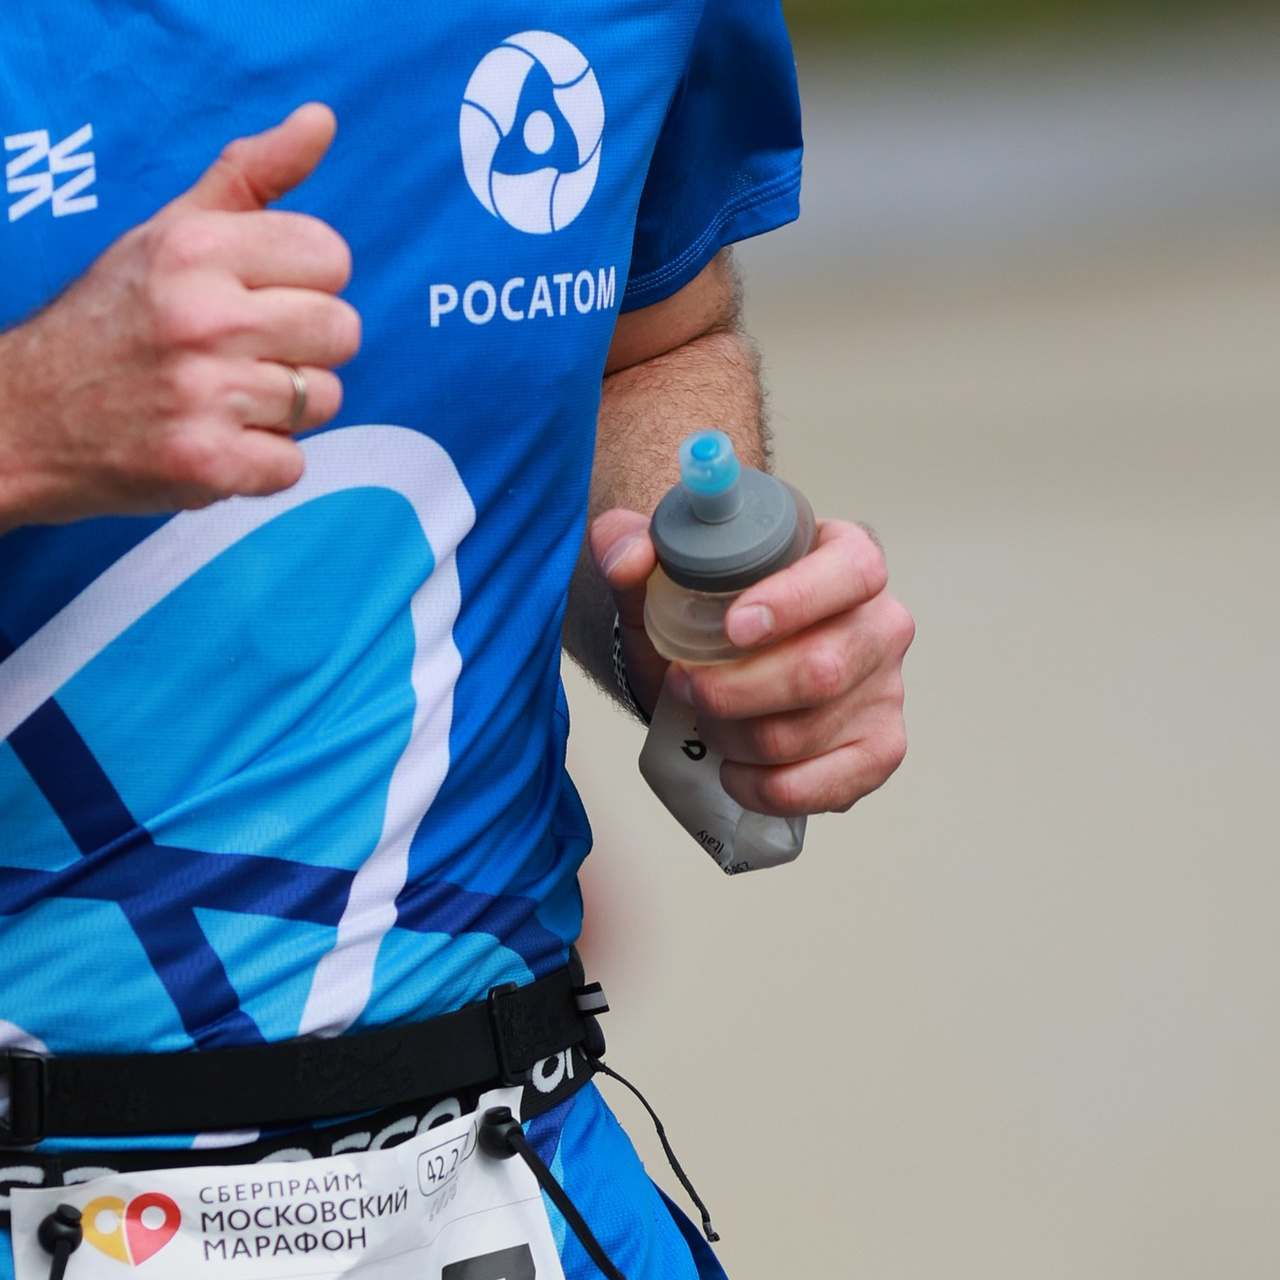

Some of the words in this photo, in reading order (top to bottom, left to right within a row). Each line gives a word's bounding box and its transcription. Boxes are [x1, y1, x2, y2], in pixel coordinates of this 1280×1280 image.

[429, 265, 616, 328] РОСАТОМ
[696, 830, 725, 854] Italy
[199, 1171, 363, 1204] СБЕРПРАЙМ
[201, 1185, 408, 1233] МОСКОВСКИЙ
[203, 1227, 367, 1261] МАРАФОН
